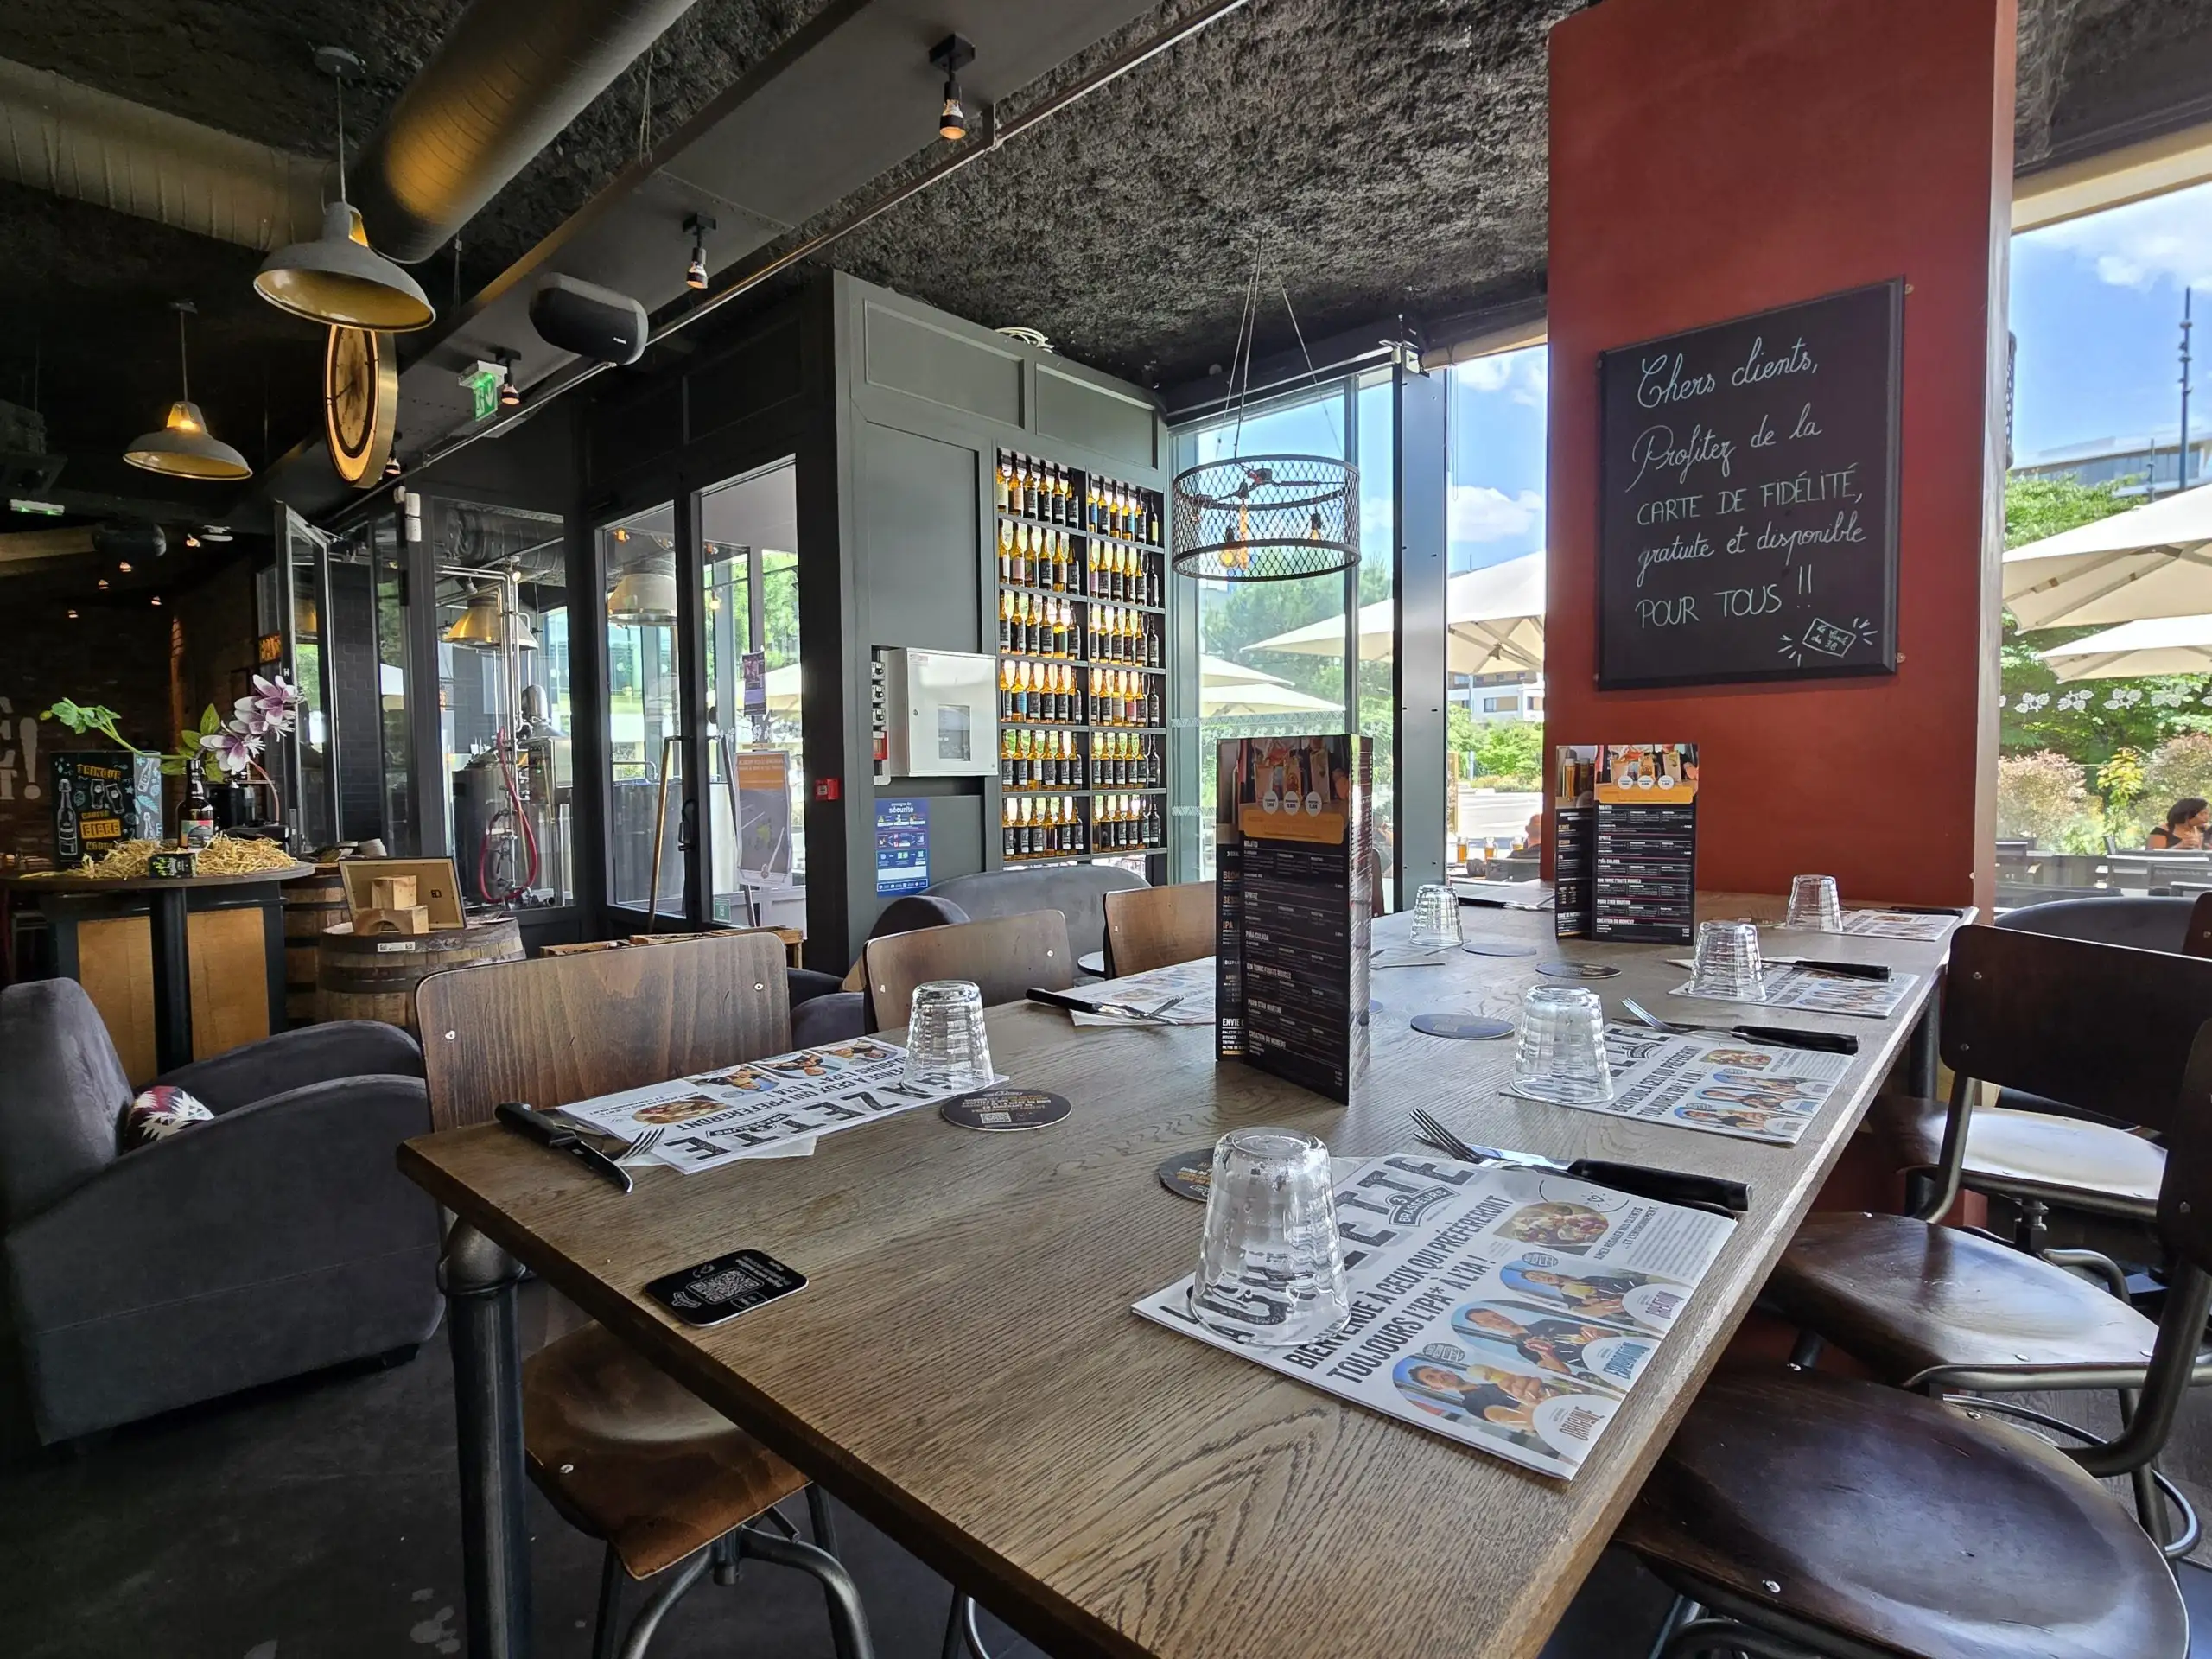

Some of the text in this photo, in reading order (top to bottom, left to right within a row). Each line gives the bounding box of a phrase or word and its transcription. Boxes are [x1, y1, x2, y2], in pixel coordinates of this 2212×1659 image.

[1637, 336, 1819, 408] Chers clients,
[1625, 403, 1822, 493] Profitez de la
[1637, 494, 1703, 525] CARTE
[1716, 488, 1747, 516] DE
[1636, 511, 1866, 588] gratuite et disponible
[1635, 596, 1700, 629] POUR
[1714, 584, 1783, 617] TOUS
[888, 805, 914, 814] sécurité
[1222, 1018, 1239, 1027] ENVIE
[789, 1090, 820, 1102] QUI
[1398, 1187, 1448, 1224] BRASSEURS
[1282, 1194, 1514, 1370] BIENVENUE À CEUX QUI PRÉFÈRERONT
[1325, 1316, 1426, 1384] TOUJOURS
[1447, 1260, 1492, 1287] L'IA
[1559, 1405, 1606, 1441] ORIGINE
